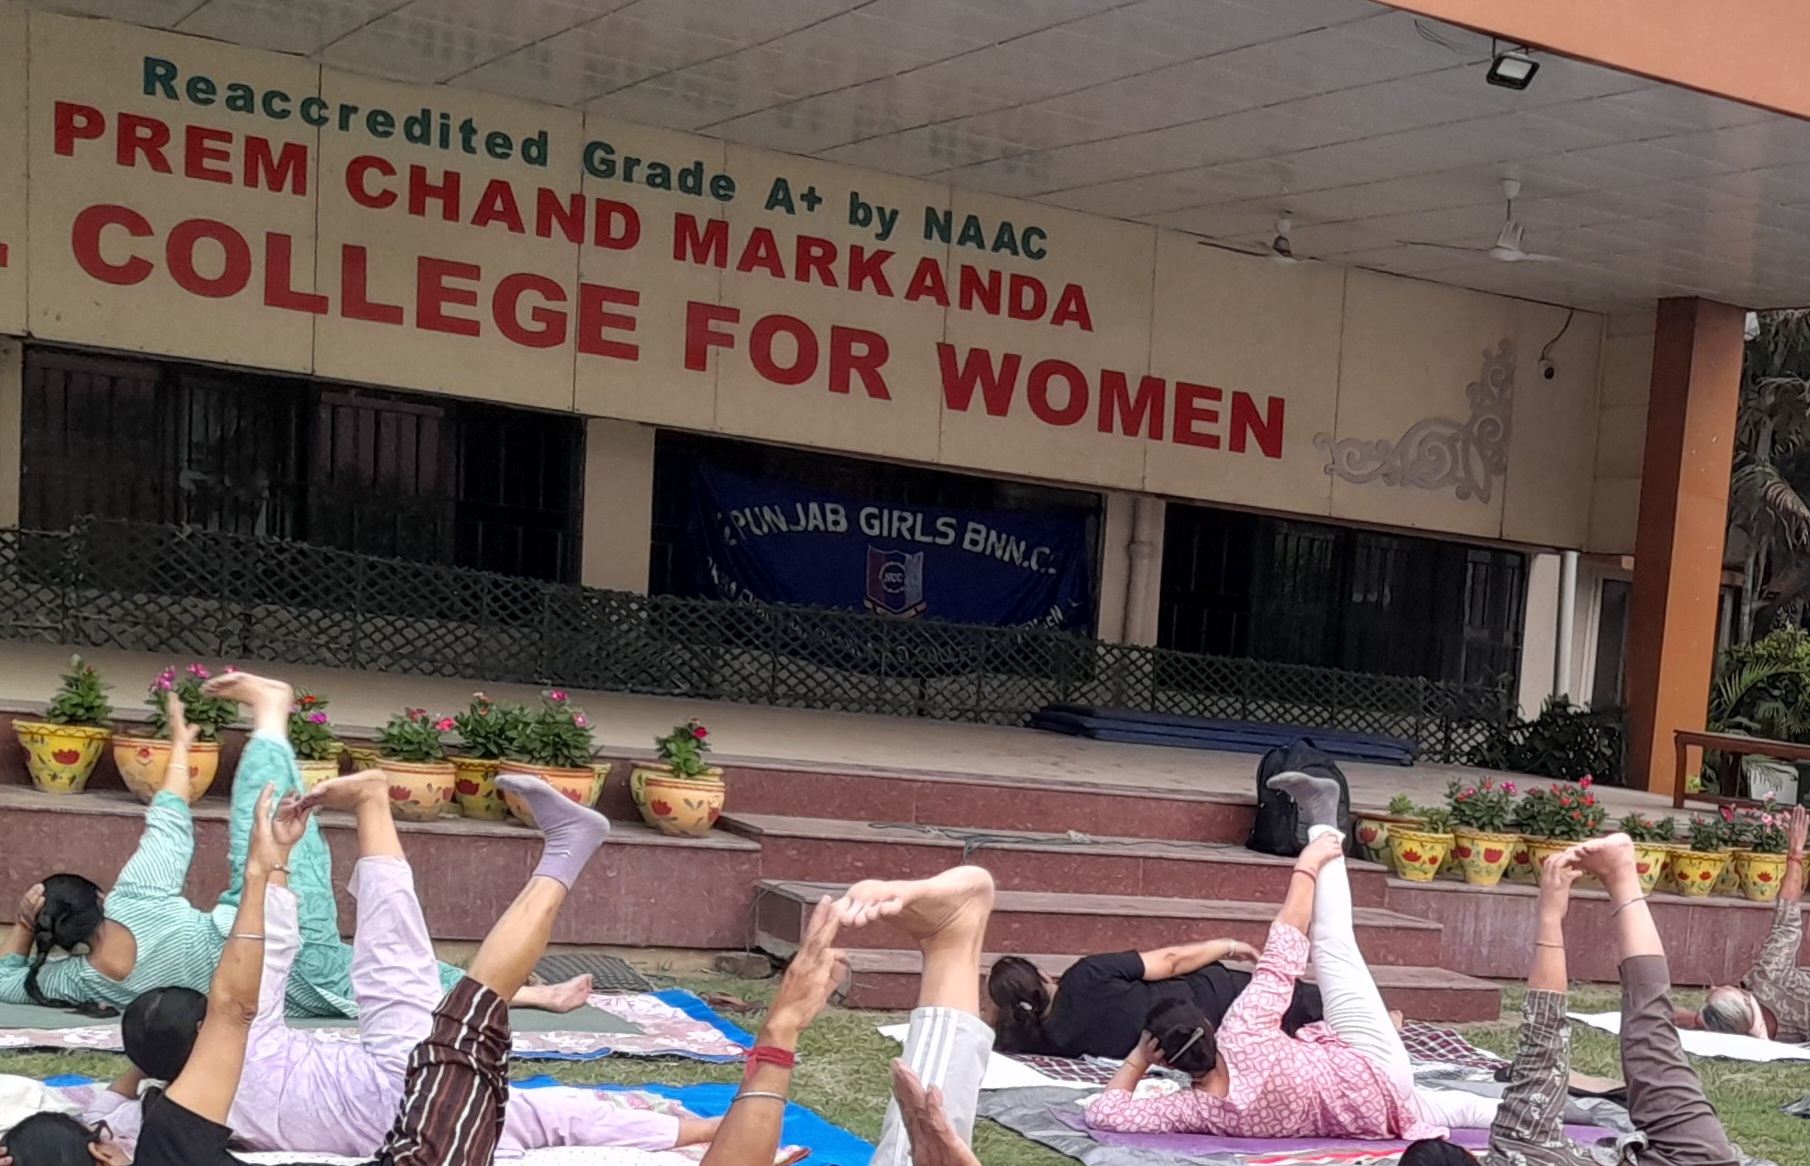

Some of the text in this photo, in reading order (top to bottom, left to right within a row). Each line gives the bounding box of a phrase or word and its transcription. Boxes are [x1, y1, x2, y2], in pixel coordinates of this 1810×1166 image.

[53, 100, 1094, 332] PREM CHAND MARKANDA
[142, 56, 1048, 260] Reaccredited Grade A+ by NAAC
[71, 203, 1285, 459] COLLEGE FOR WOMEN
[729, 501, 849, 541] PUNJAB
[858, 506, 957, 545] GIRLS
